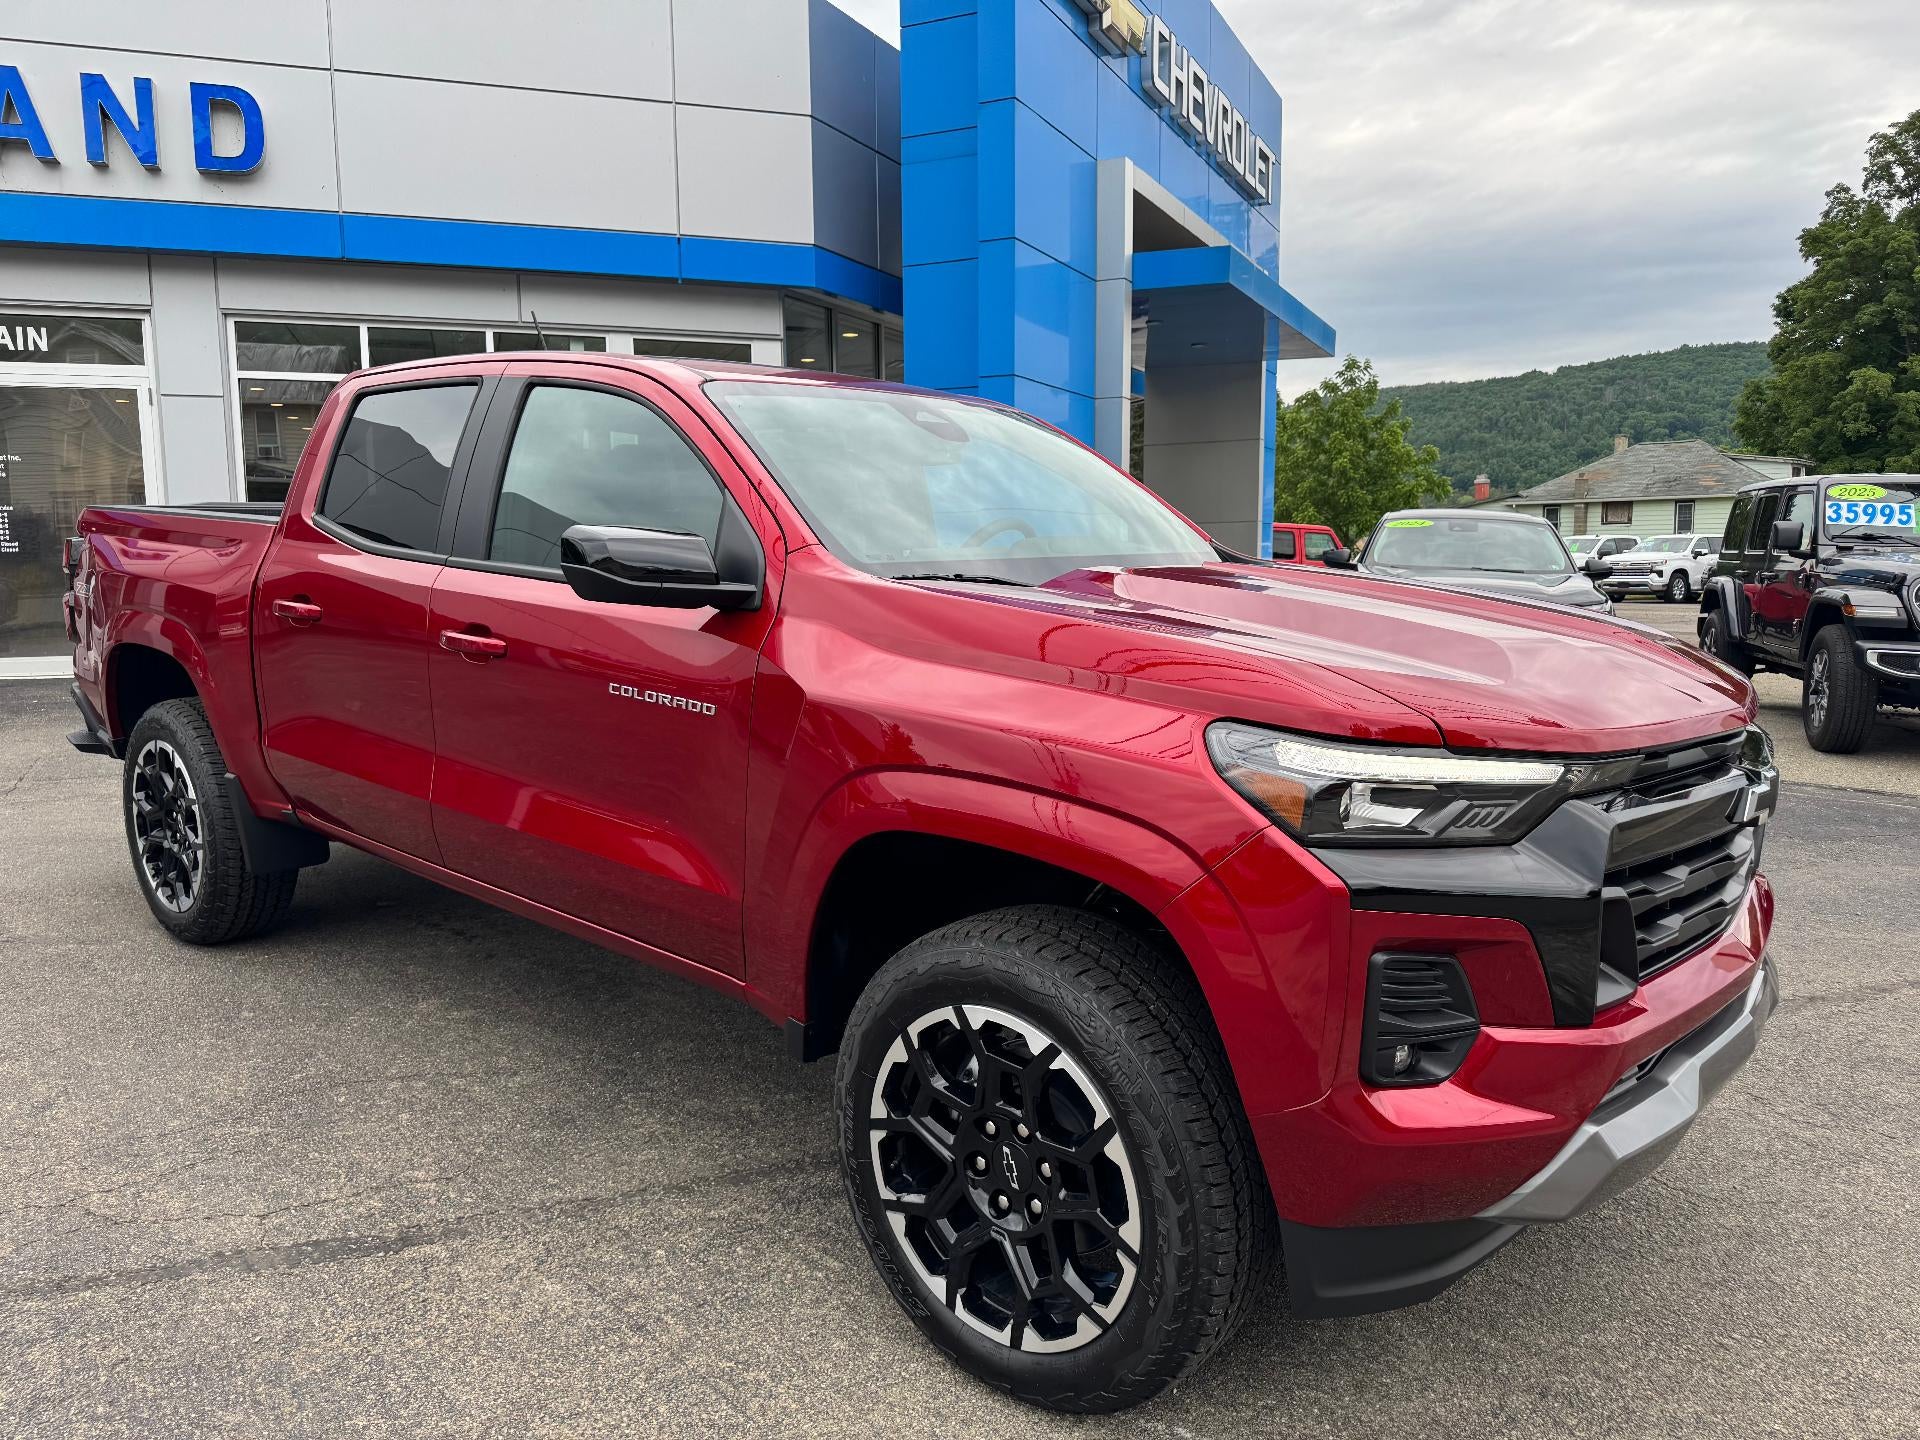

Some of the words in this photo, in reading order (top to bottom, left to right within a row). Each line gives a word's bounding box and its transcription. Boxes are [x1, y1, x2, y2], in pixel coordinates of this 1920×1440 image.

[0, 64, 265, 174] AND
[1149, 13, 1276, 205] CHEVROLET
[0, 325, 49, 352] AIN
[1838, 487, 1877, 498] 2025
[1827, 502, 1914, 526] 35995
[608, 682, 717, 716] COLORADO
